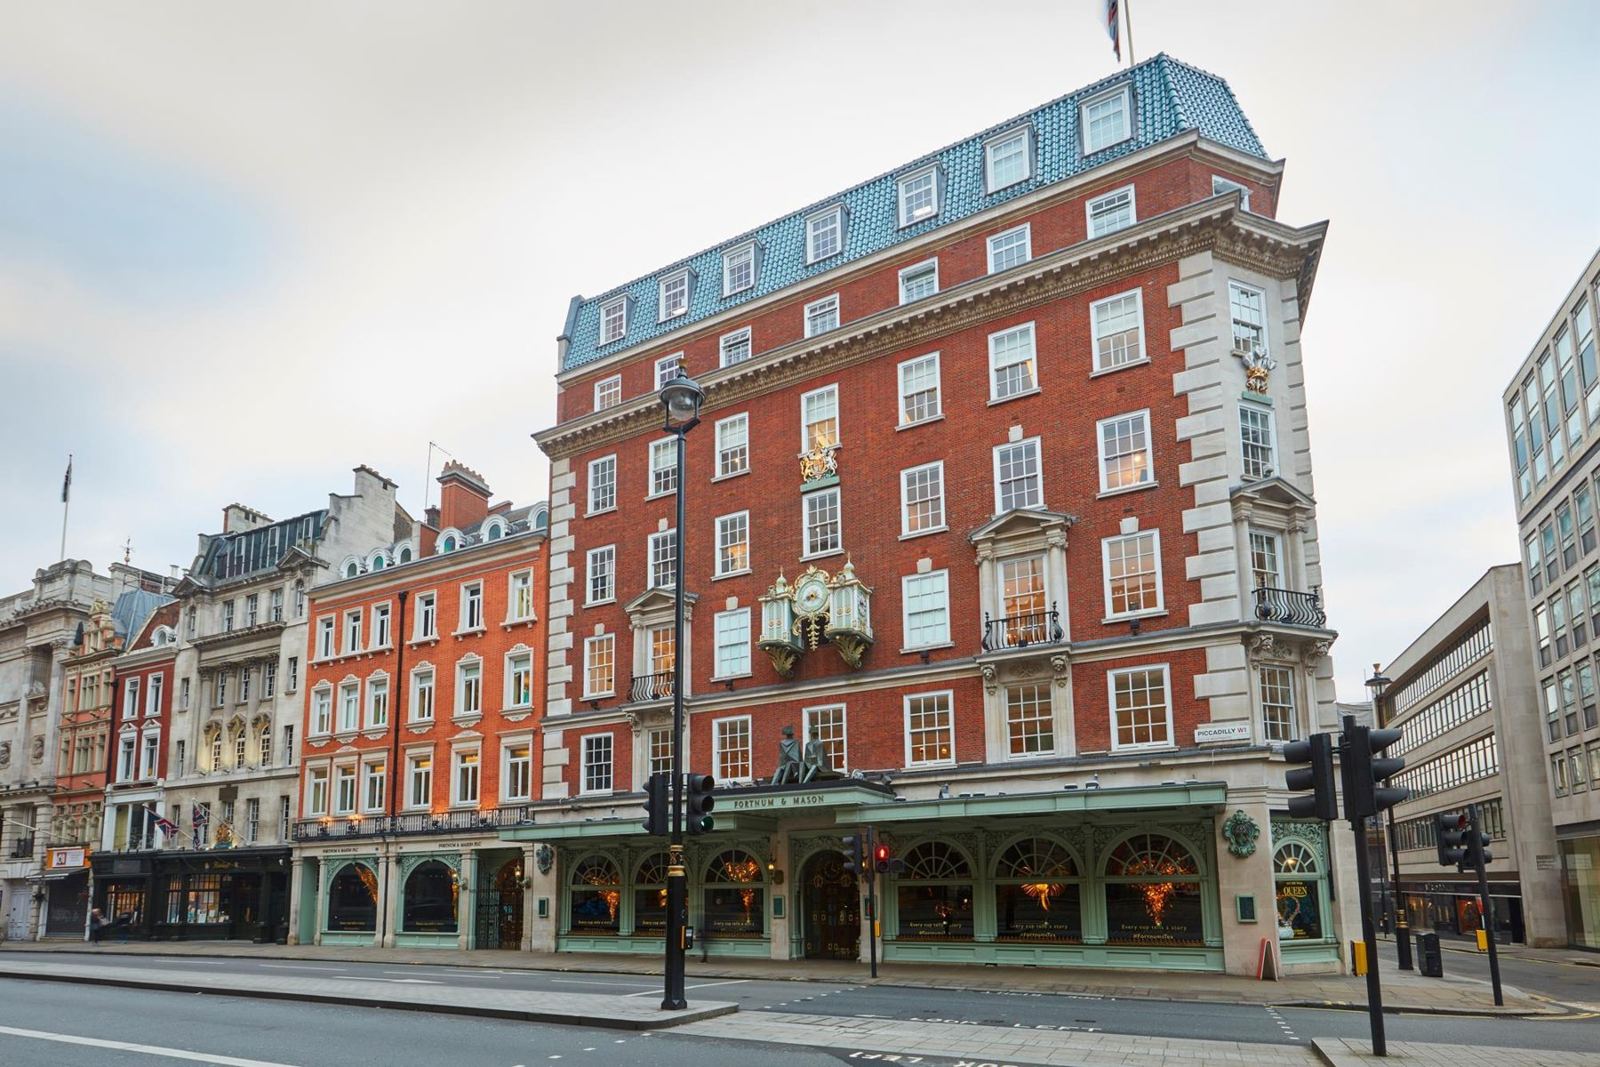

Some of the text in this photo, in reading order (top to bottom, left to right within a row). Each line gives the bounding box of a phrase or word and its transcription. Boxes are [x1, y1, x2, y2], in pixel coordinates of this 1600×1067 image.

[1198, 728, 1236, 736] PICCADILLY
[734, 799, 774, 808] FORTNUM
[794, 795, 824, 804] MASON
[1284, 886, 1308, 897] QUEEN
